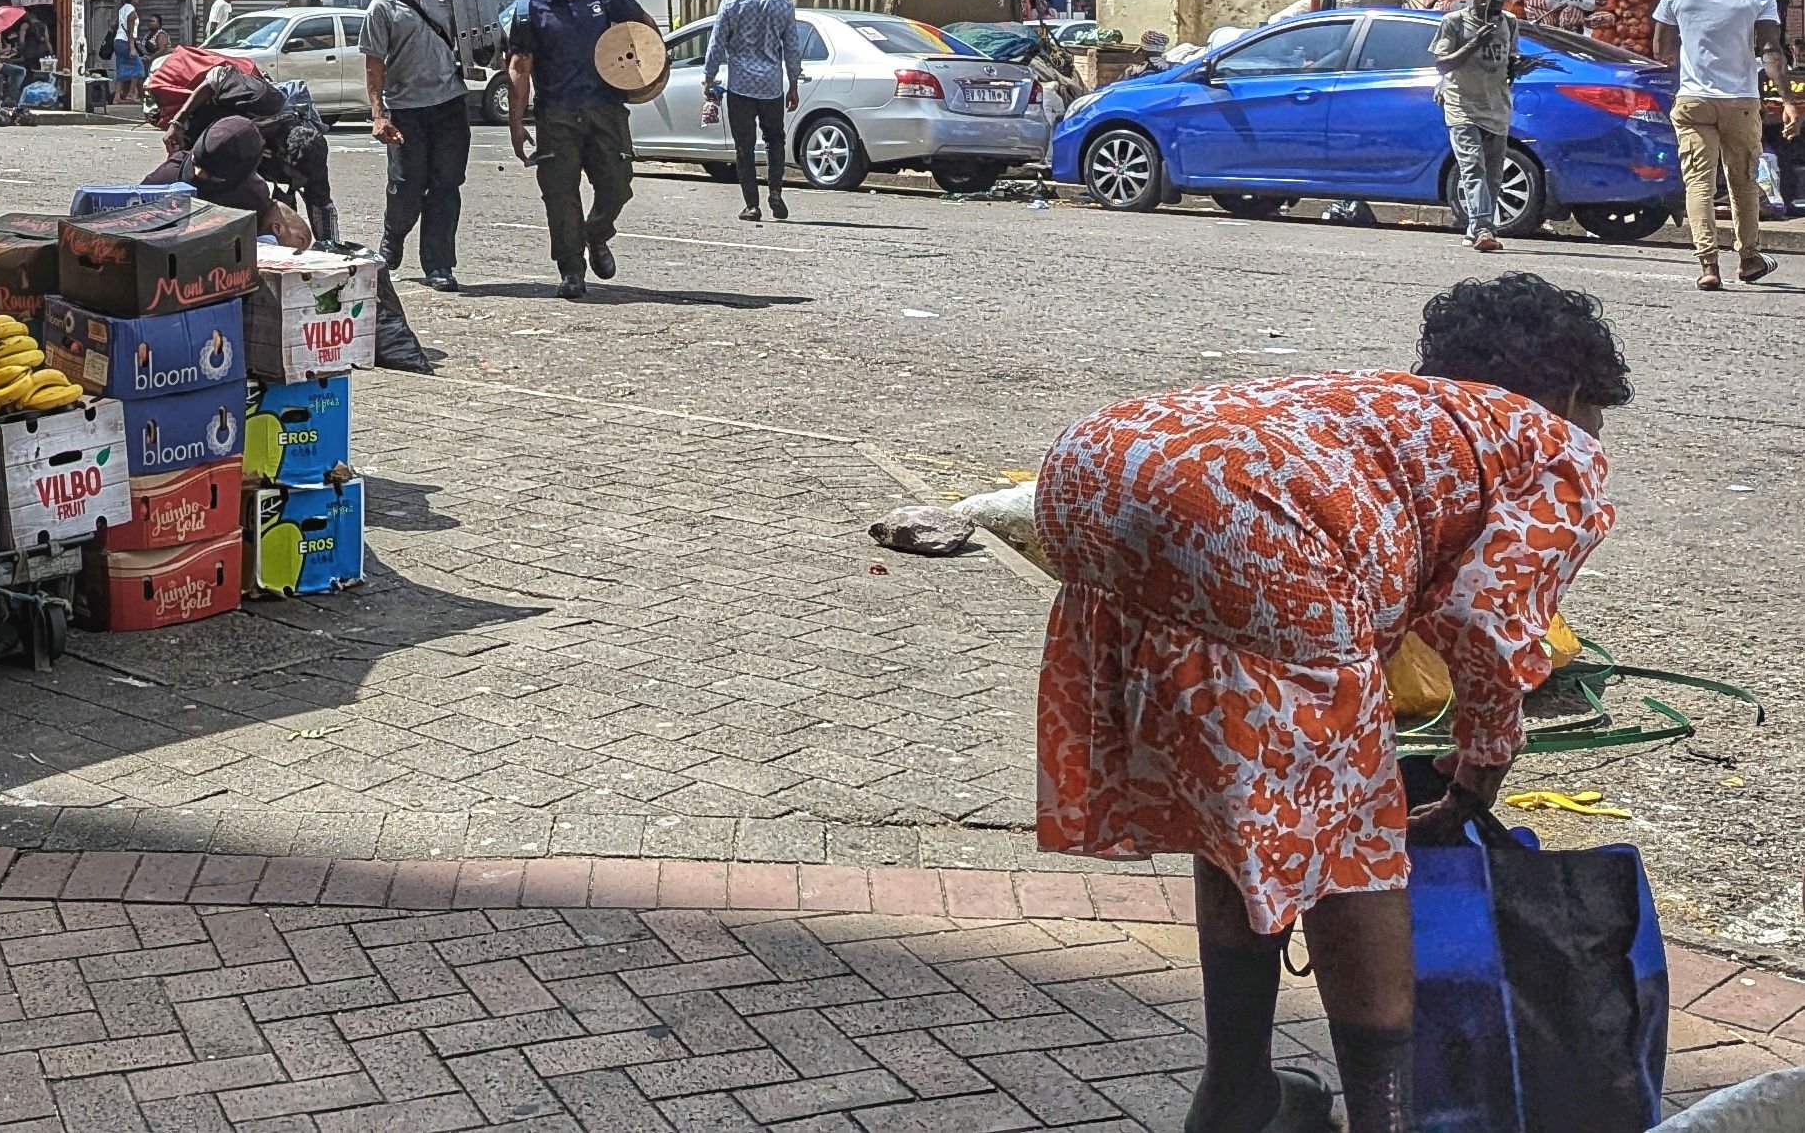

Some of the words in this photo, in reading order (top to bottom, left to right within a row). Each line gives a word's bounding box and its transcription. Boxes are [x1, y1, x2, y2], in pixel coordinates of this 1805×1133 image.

[147, 275, 203, 310] Mont
[208, 266, 252, 291] Rouge
[303, 317, 354, 351] VILBO
[135, 351, 198, 391] bloom
[318, 347, 341, 363] FRUIT
[143, 426, 205, 466] bloom
[279, 431, 318, 446] EROS
[35, 466, 102, 508] VILBO
[56, 499, 87, 521] FRUIT
[150, 498, 201, 537] Jumbo
[176, 512, 206, 541] Gold
[299, 538, 334, 554] EROS
[154, 576, 207, 615] Jumbo
[180, 589, 212, 618] Gold
